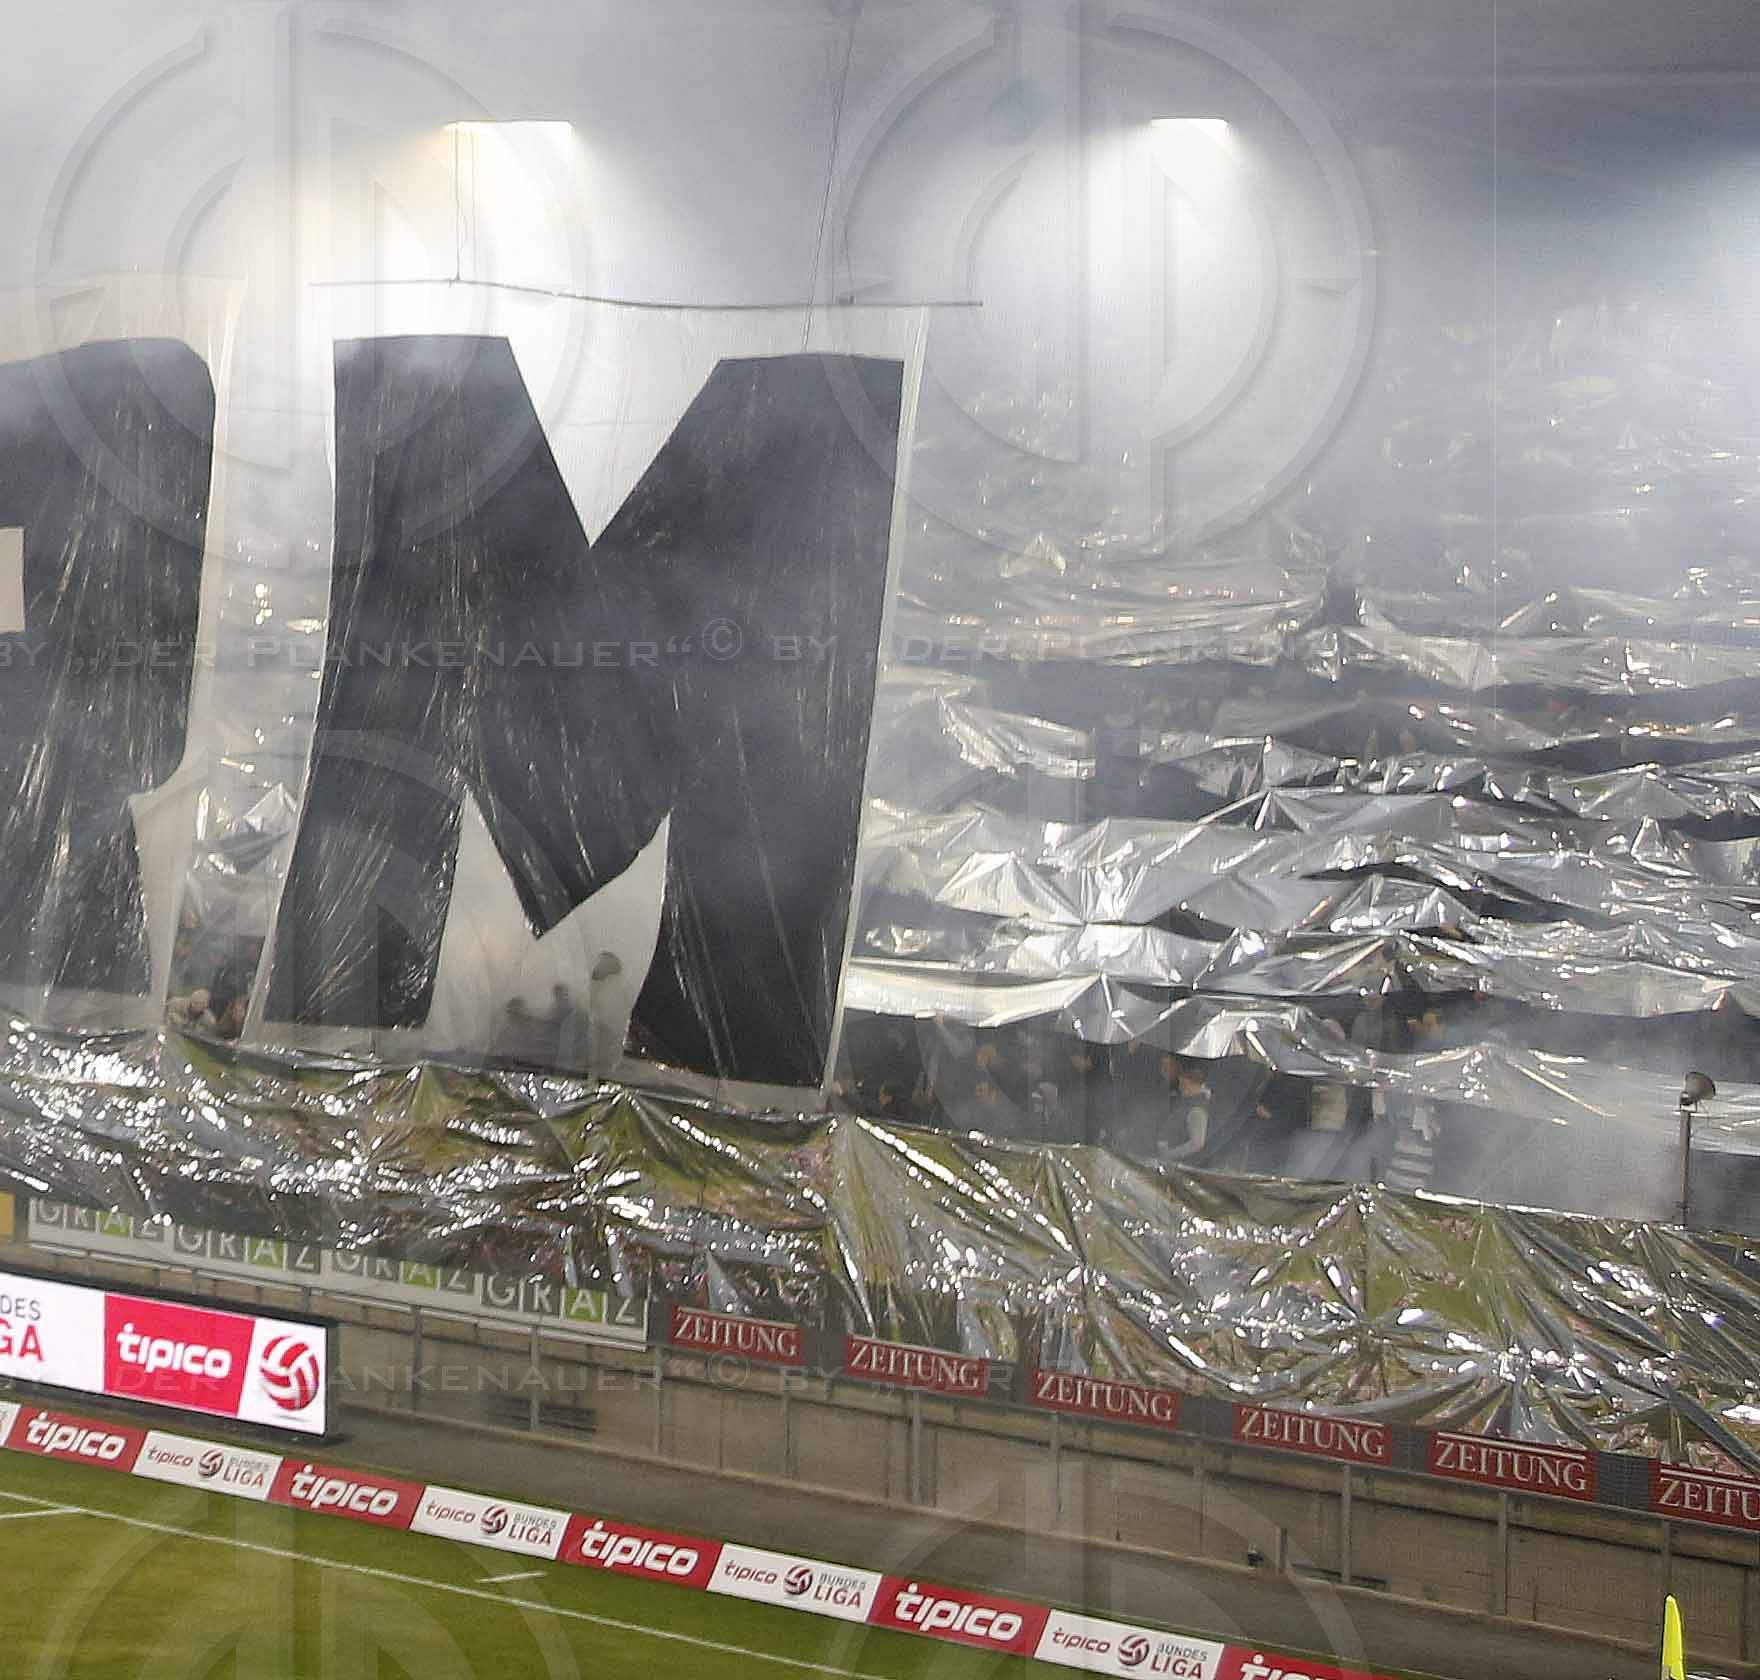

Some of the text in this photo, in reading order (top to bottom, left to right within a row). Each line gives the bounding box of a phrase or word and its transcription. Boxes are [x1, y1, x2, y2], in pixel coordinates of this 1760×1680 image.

[488, 1272, 637, 1325] GRAZ
[116, 1322, 233, 1380] tipico
[674, 1312, 798, 1358] ZEITUNG
[849, 1342, 980, 1391] ZEITUNG
[1036, 1372, 1173, 1421] ZEITUNG
[26, 1409, 128, 1462] tipico
[1240, 1408, 1385, 1458] ZEITUNG
[223, 1464, 266, 1490] LIGA
[1435, 1439, 1586, 1492] ZEITUNG
[289, 1463, 400, 1518] tipico
[425, 1499, 476, 1525] tipico
[1659, 1477, 1760, 1522] ZEITU
[509, 1520, 552, 1547] LIGA
[581, 1519, 699, 1577] tipico
[722, 1559, 778, 1586] tipico
[814, 1585, 862, 1610] LIGA
[895, 1582, 1024, 1641] tipico
[1051, 1625, 1111, 1655] tipico
[1153, 1655, 1203, 1680] LIGA
